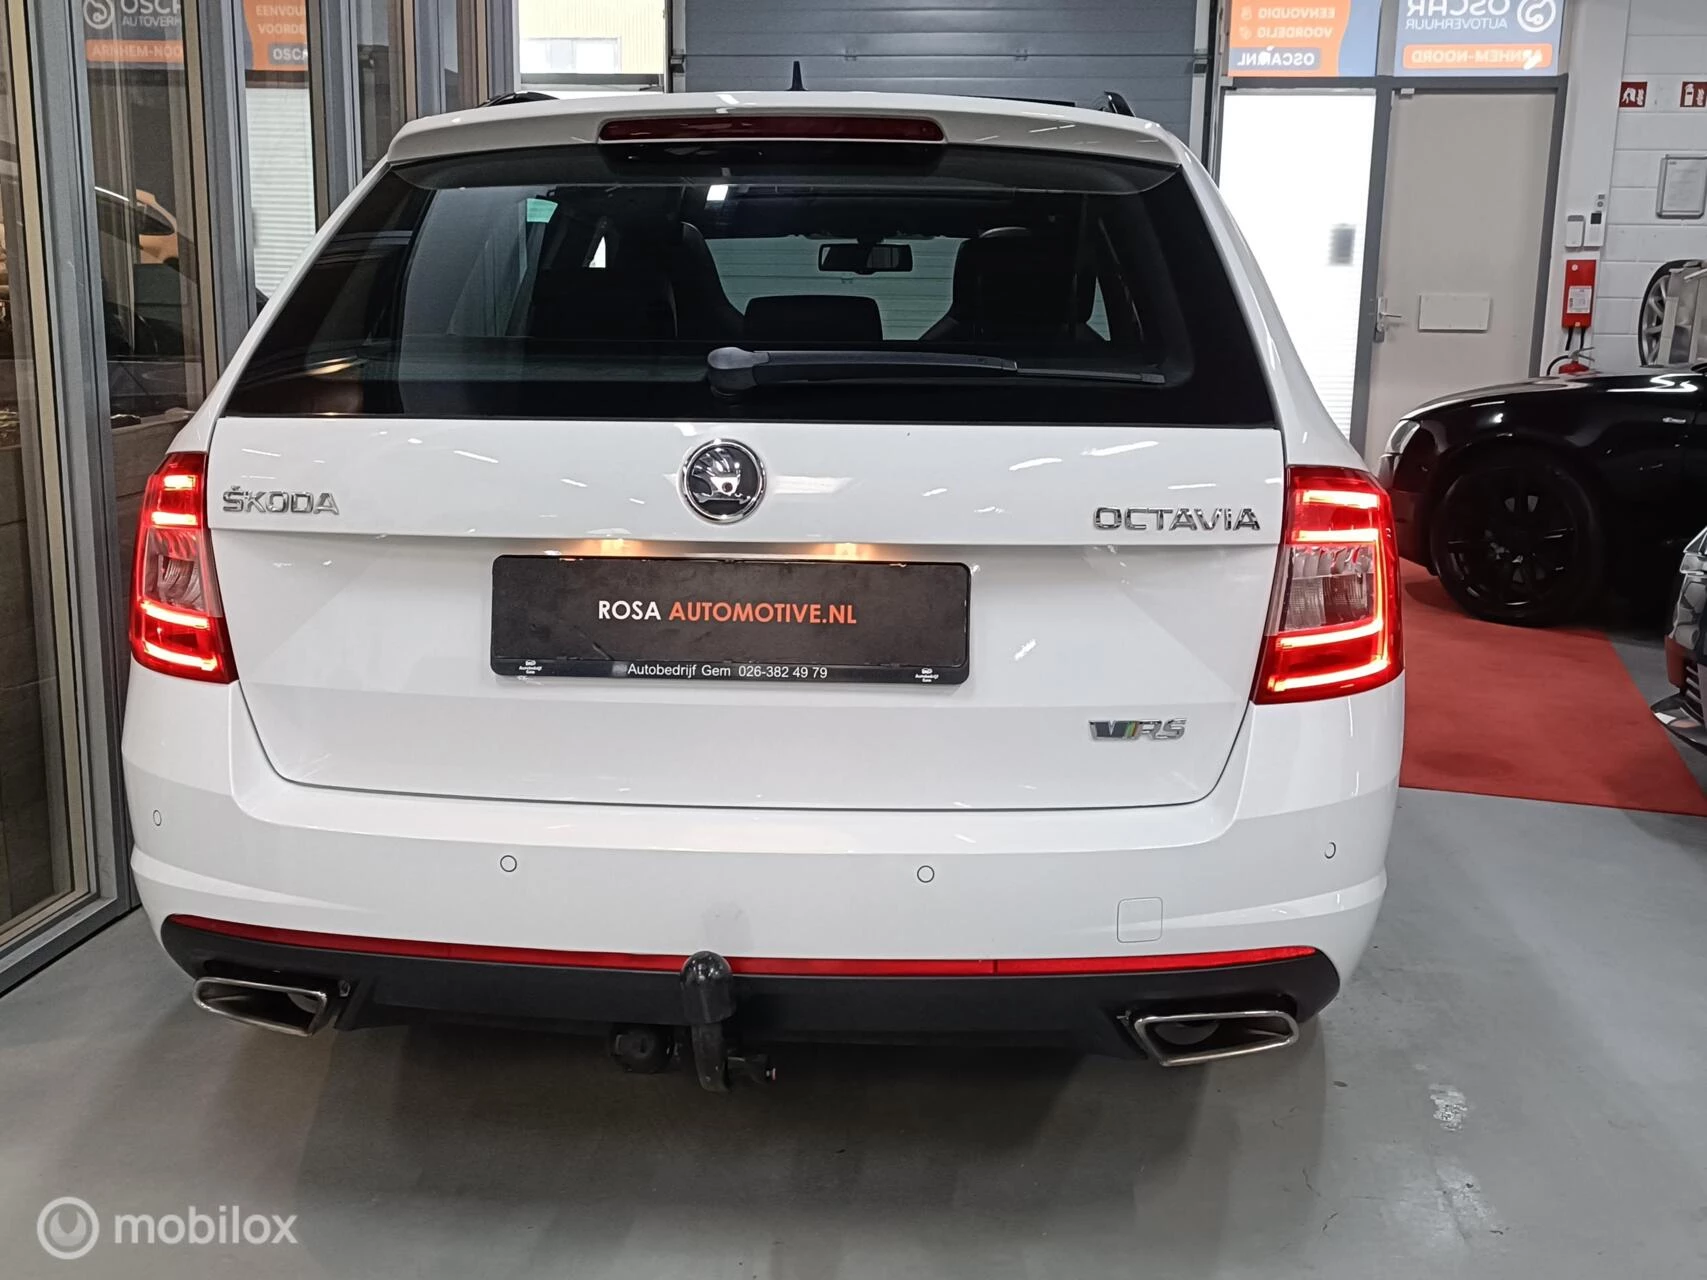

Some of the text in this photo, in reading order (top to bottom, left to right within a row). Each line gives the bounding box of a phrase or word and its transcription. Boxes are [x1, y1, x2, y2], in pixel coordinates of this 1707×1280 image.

[222, 486, 339, 515] ŠKODA
[1095, 508, 1261, 530] OCTAVIA
[598, 600, 857, 625] ROSA AUTOMOTIVE.NL
[627, 663, 828, 679] Autobedrijf Gem 026-382 49 79
